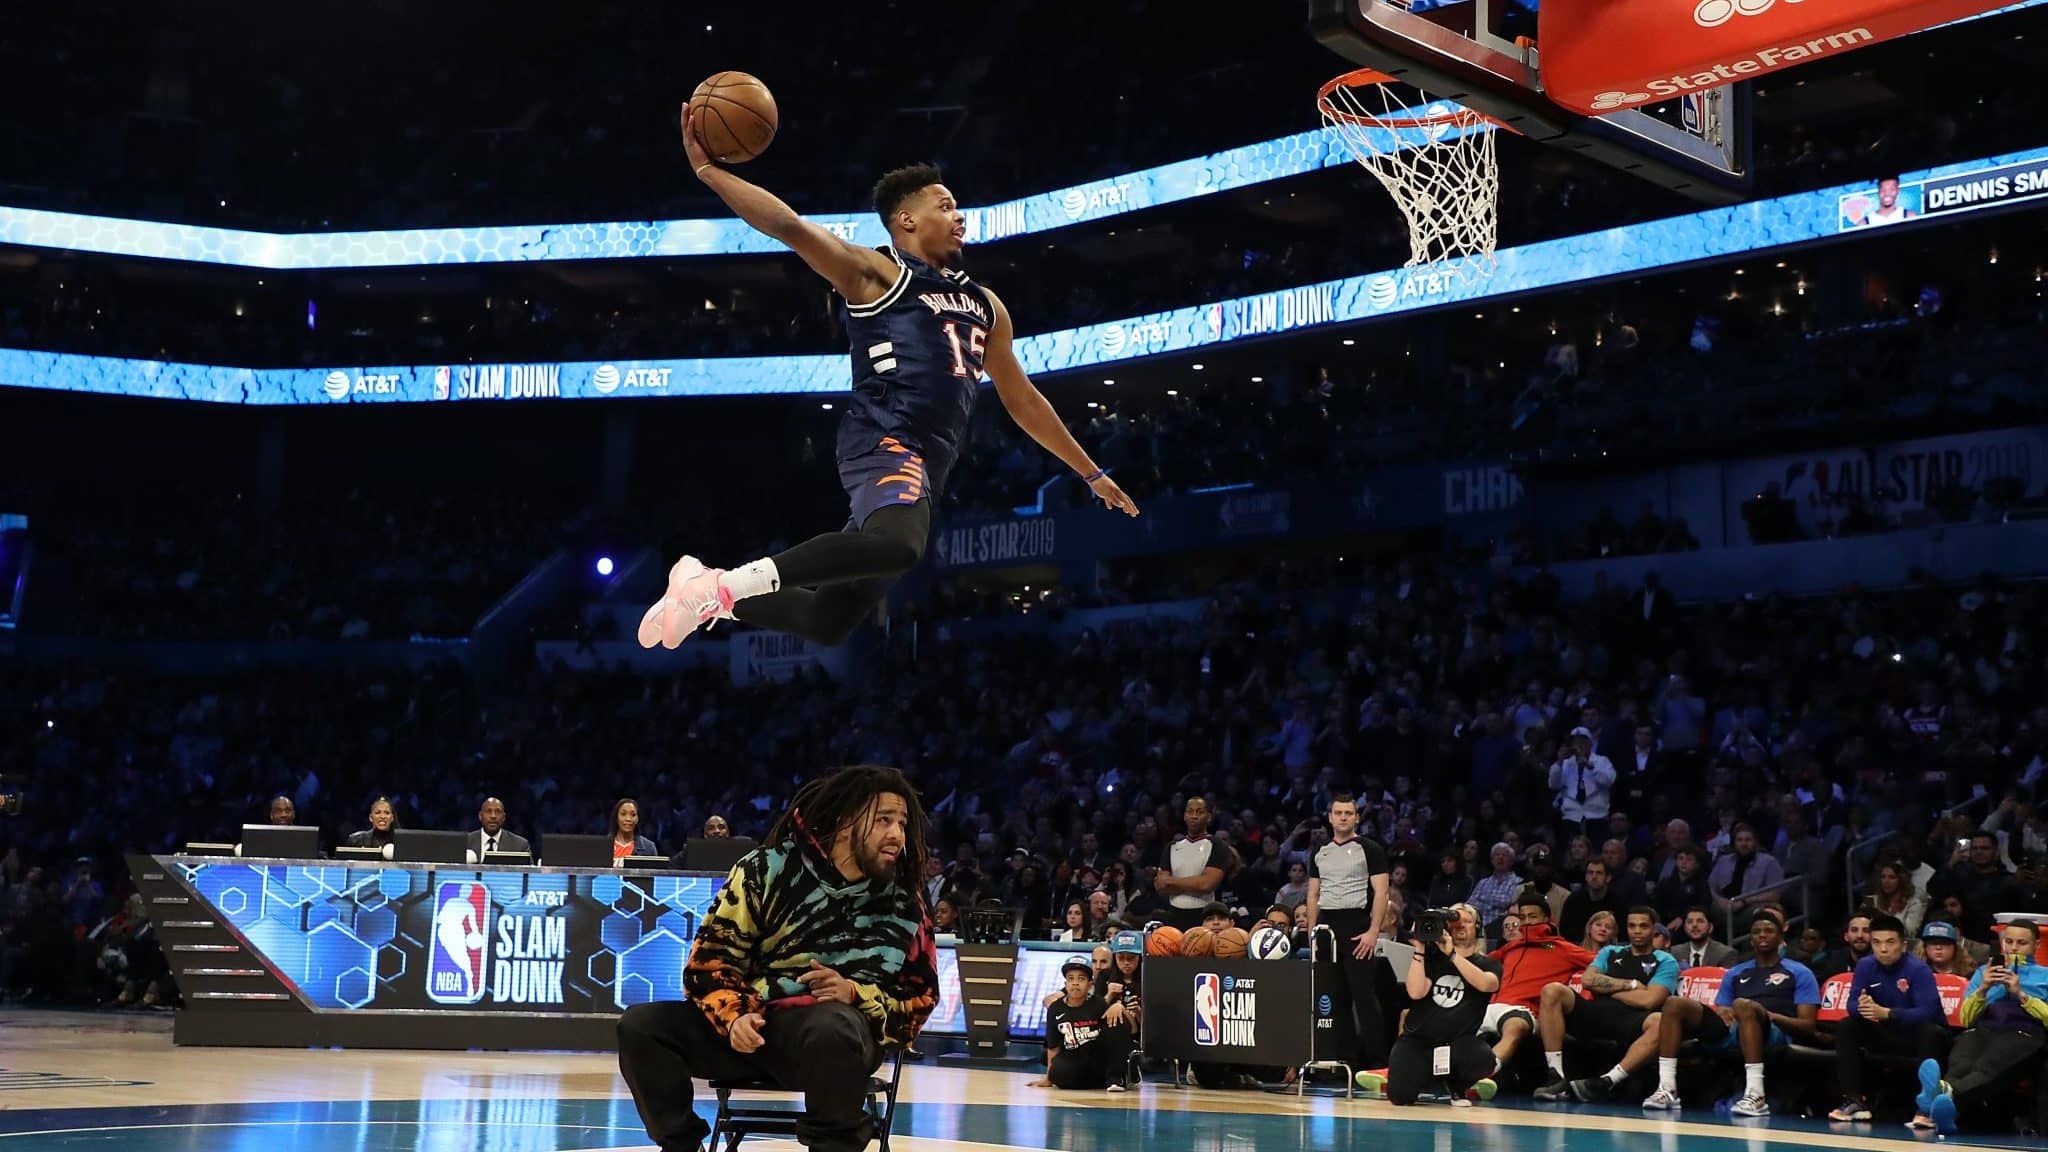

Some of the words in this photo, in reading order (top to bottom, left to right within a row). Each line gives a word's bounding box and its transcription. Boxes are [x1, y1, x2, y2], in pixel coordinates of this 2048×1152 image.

[1646, 59, 1760, 96] State
[1756, 27, 1873, 67] Farm
[1089, 183, 1130, 210] AT&T
[1929, 176, 2010, 209] DENNIS
[986, 201, 1027, 239] DUNK
[1402, 271, 1453, 300] AT&T
[1231, 295, 1277, 336] SLAM
[1282, 287, 1335, 329] DUNK
[1130, 320, 1174, 346] AT&T
[942, 320, 988, 382] 15
[353, 375, 400, 395] AT&T
[457, 365, 505, 399] SLAM
[510, 364, 561, 398] DUNK
[623, 367, 673, 388] AT&T
[525, 890, 569, 906] AT&T
[495, 914, 566, 959] SLAM
[435, 971, 463, 992] NBA
[493, 959, 565, 1003] DUNK
[1235, 978, 1256, 989] AT&T
[1222, 992, 1256, 1020] SLAM
[1222, 1020, 1256, 1047] DUNK
[1316, 1018, 1334, 1029] AT&T
